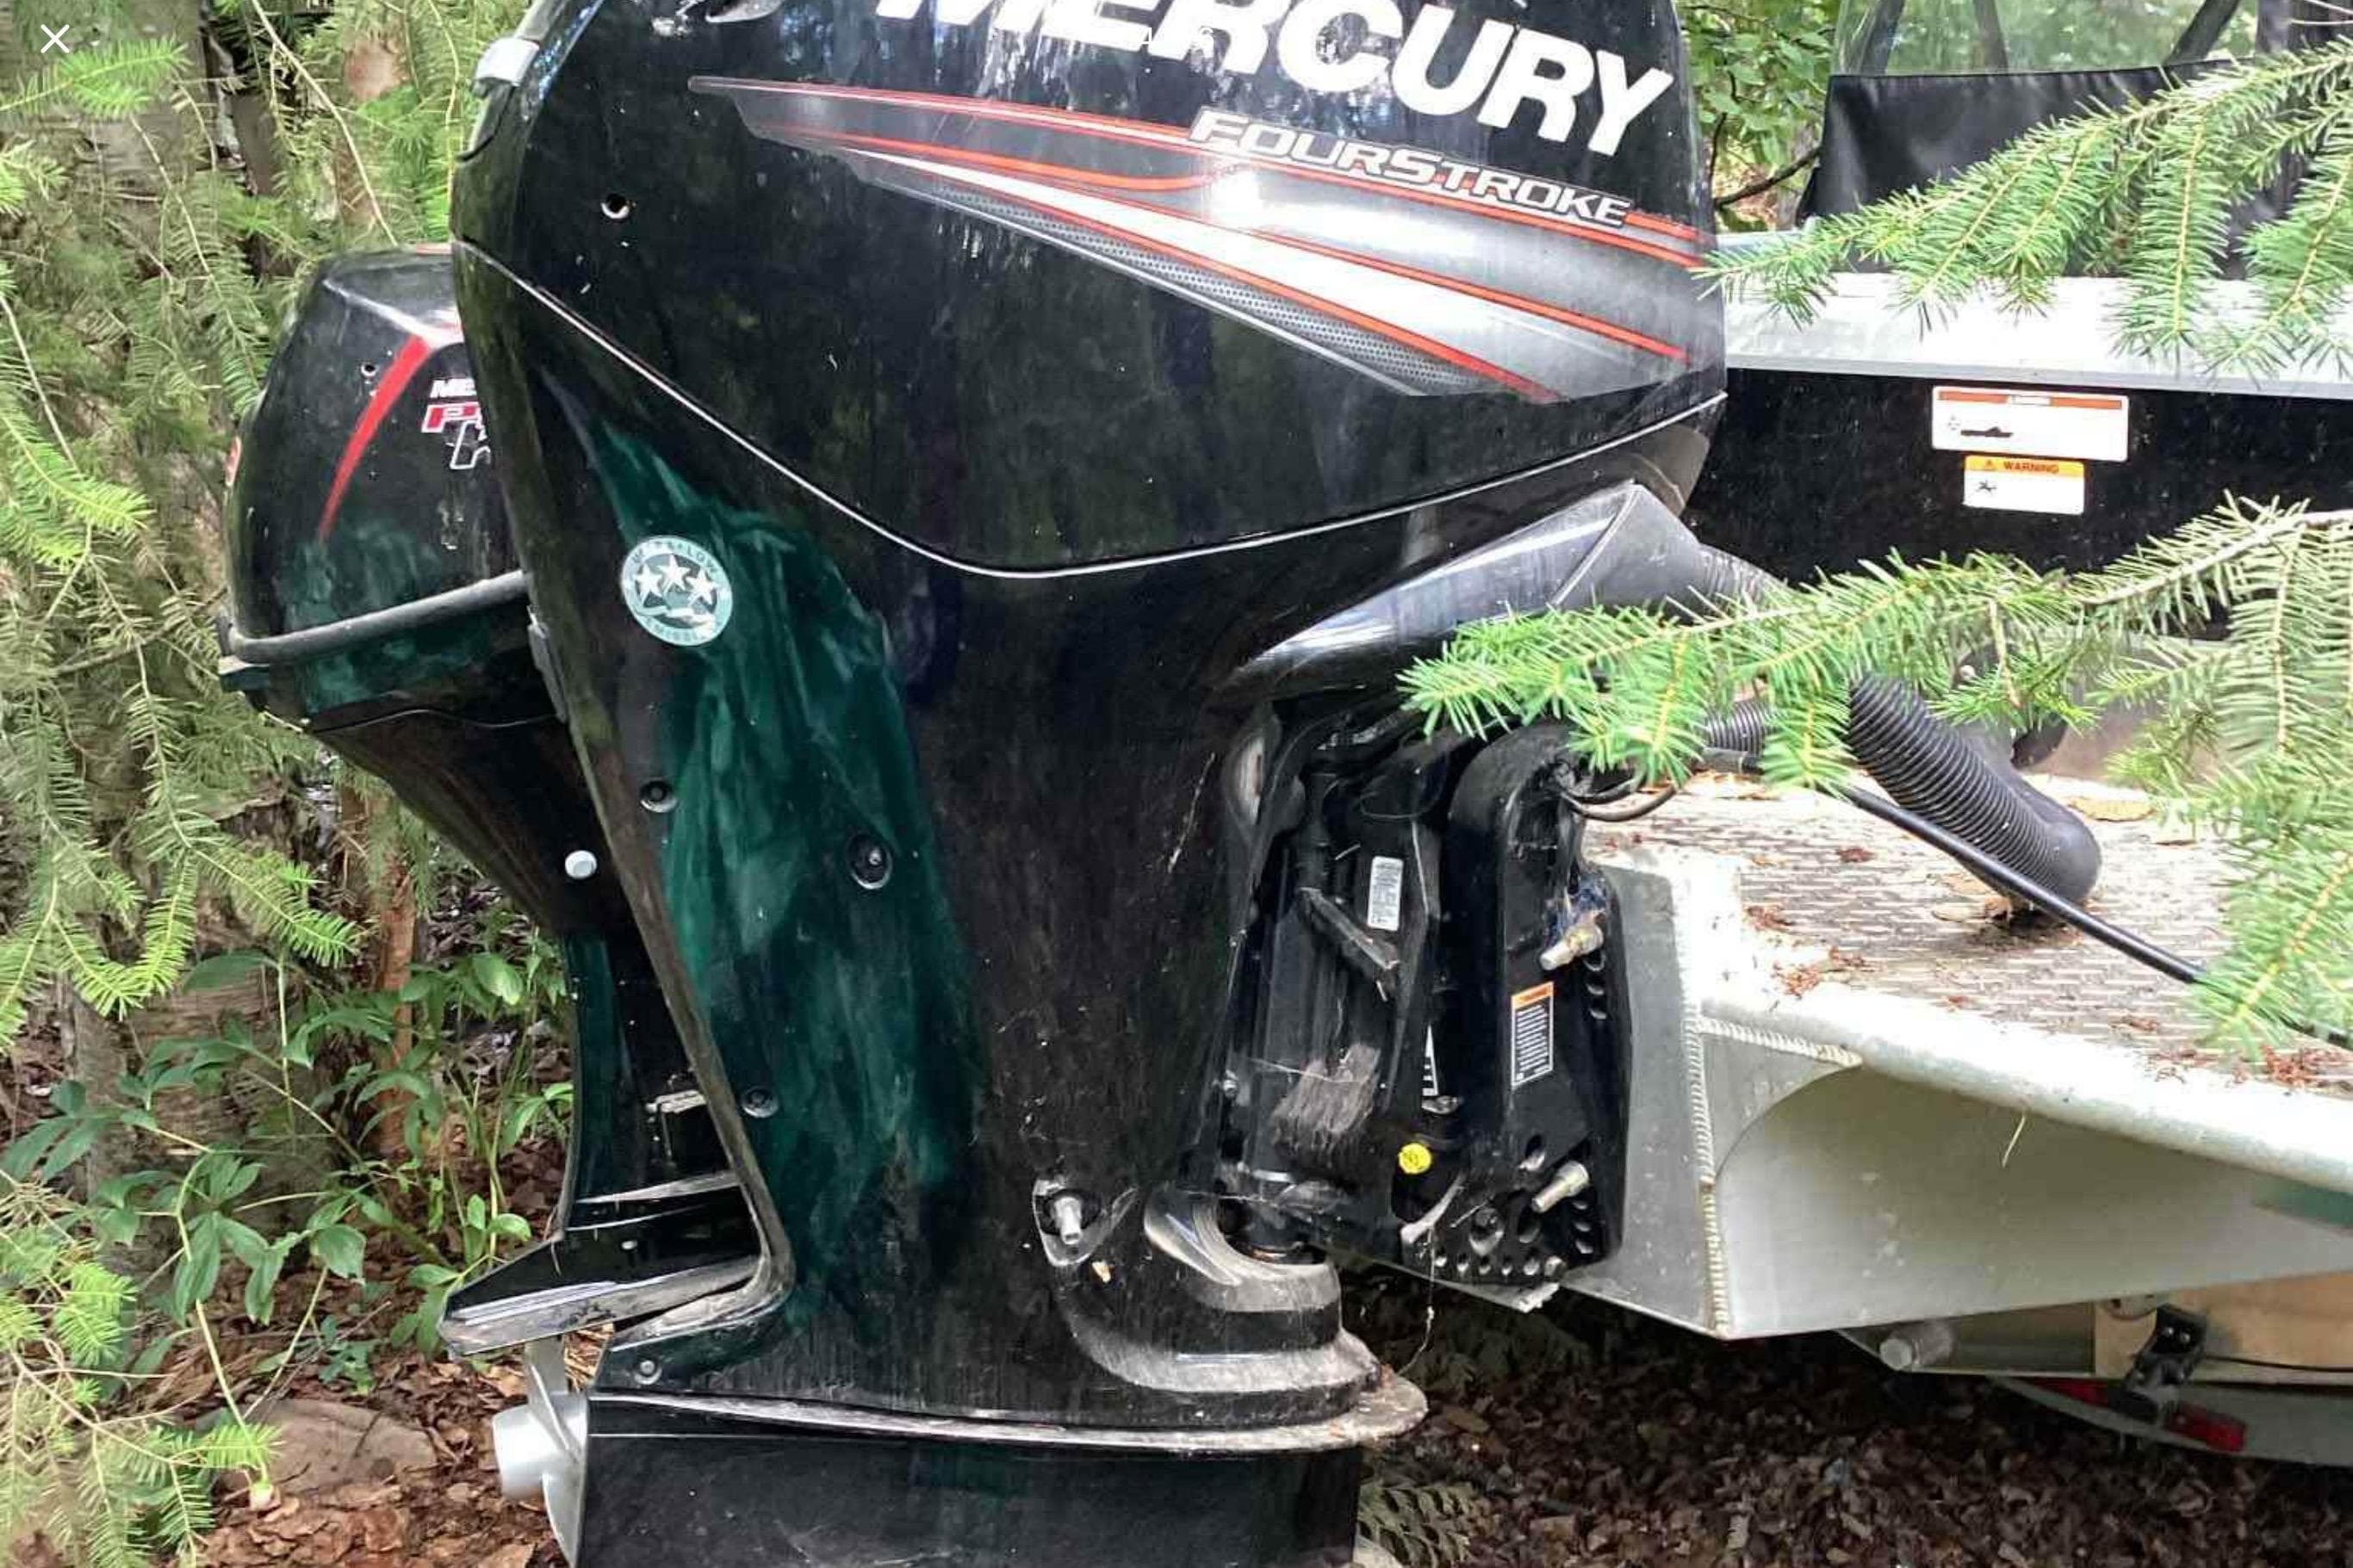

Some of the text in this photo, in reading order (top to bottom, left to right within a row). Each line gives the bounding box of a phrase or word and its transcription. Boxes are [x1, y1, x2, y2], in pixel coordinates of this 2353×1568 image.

[876, 0, 1674, 156] RCURY
[1189, 108, 1630, 226] FOURSTROKE
[2002, 461, 2059, 474] WARNING
